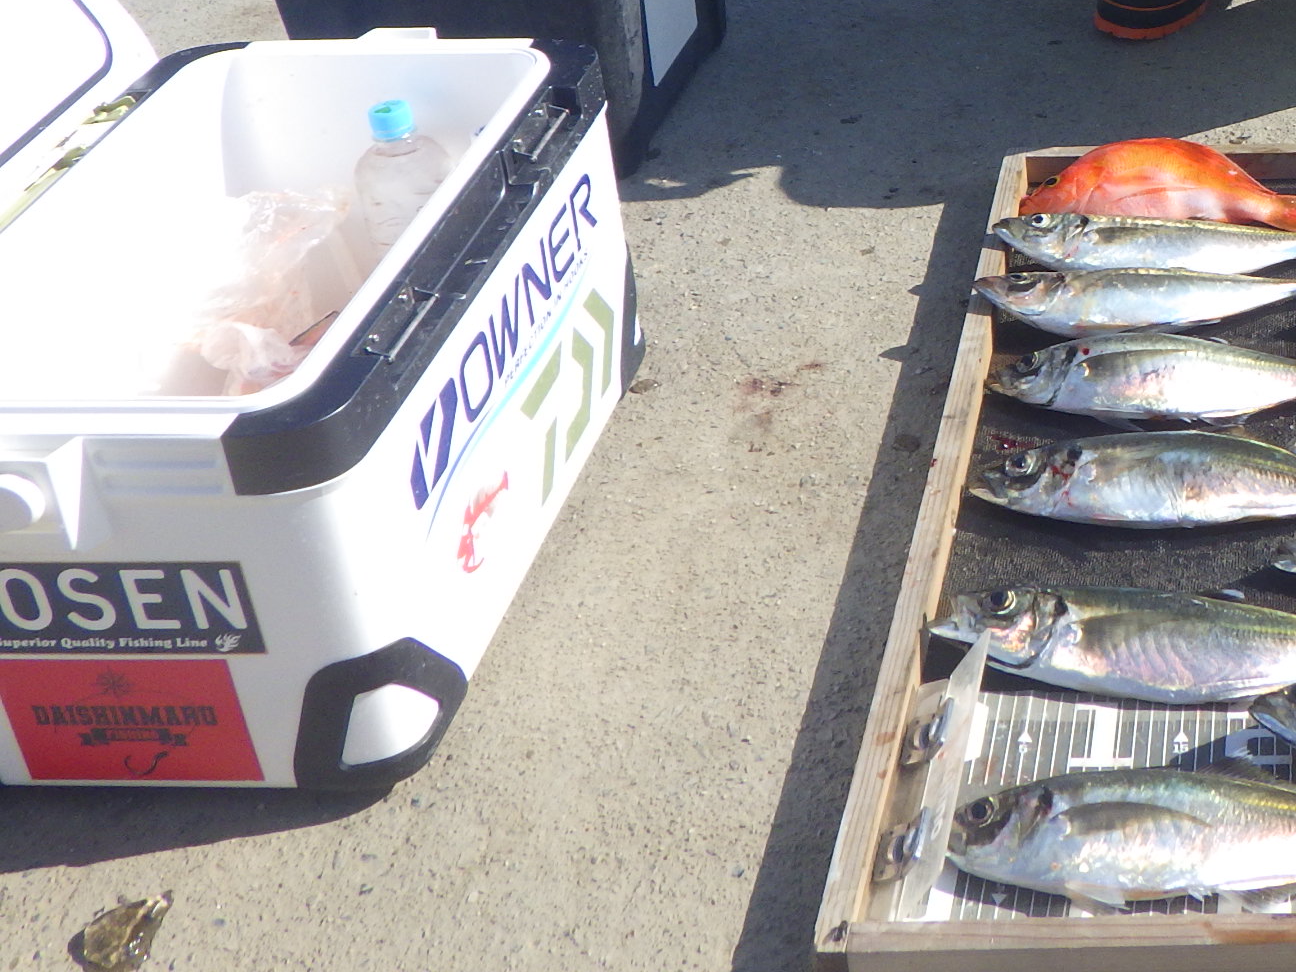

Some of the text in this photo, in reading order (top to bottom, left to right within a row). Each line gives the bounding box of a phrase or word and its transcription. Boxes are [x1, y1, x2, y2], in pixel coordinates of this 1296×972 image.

[459, 173, 598, 424] OWNER
[0, 568, 248, 631] OSEN
[60, 637, 115, 649] Quality
[119, 637, 172, 649] Fishing
[176, 637, 207, 648] Line
[32, 705, 218, 726] DAISHINMARU
